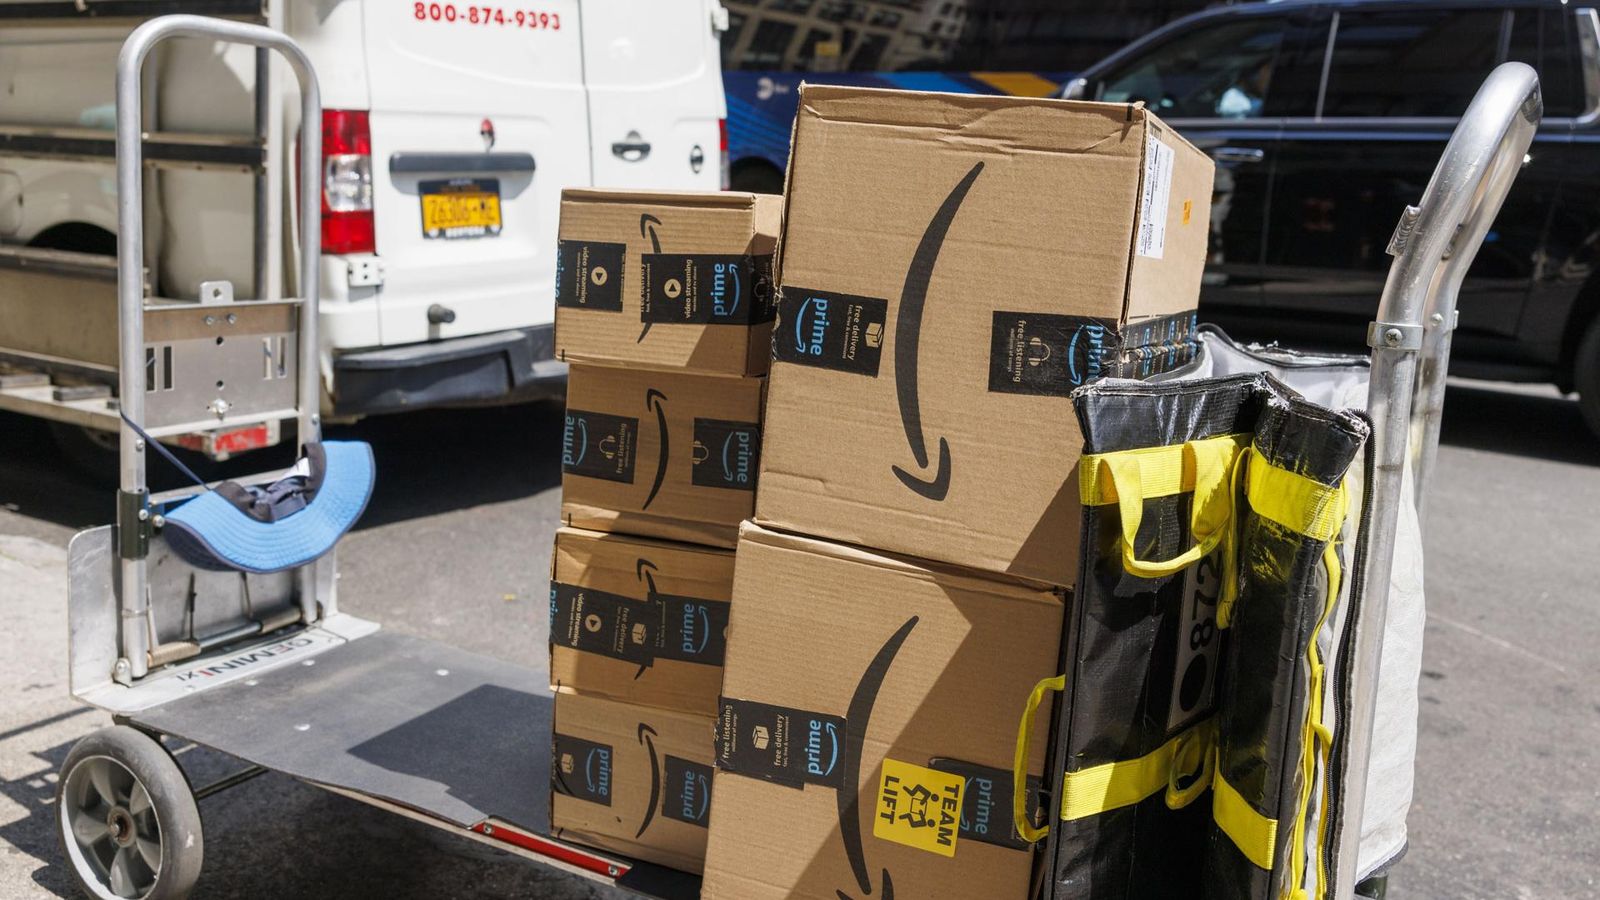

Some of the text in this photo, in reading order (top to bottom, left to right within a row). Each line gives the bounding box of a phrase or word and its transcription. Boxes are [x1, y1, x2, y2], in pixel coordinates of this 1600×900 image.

[414, 2, 561, 31] 800-874-9393
[579, 246, 590, 304] video streaming
[684, 258, 693, 297] streaming
[710, 263, 728, 316] prime
[810, 297, 831, 356] prime
[847, 305, 863, 361] free delivery
[1013, 320, 1027, 383] free listening
[735, 431, 753, 483] prime
[570, 593, 584, 647] video streaming
[679, 603, 696, 653] prime
[199, 637, 314, 677] GEMINI
[722, 704, 733, 759] free listening
[774, 714, 785, 766] free delivery
[804, 719, 824, 776] prime
[596, 748, 612, 796] prime
[680, 770, 696, 819] prime
[880, 775, 900, 825] LIFT
[937, 783, 960, 847] TEAM
[975, 777, 995, 835] prime
